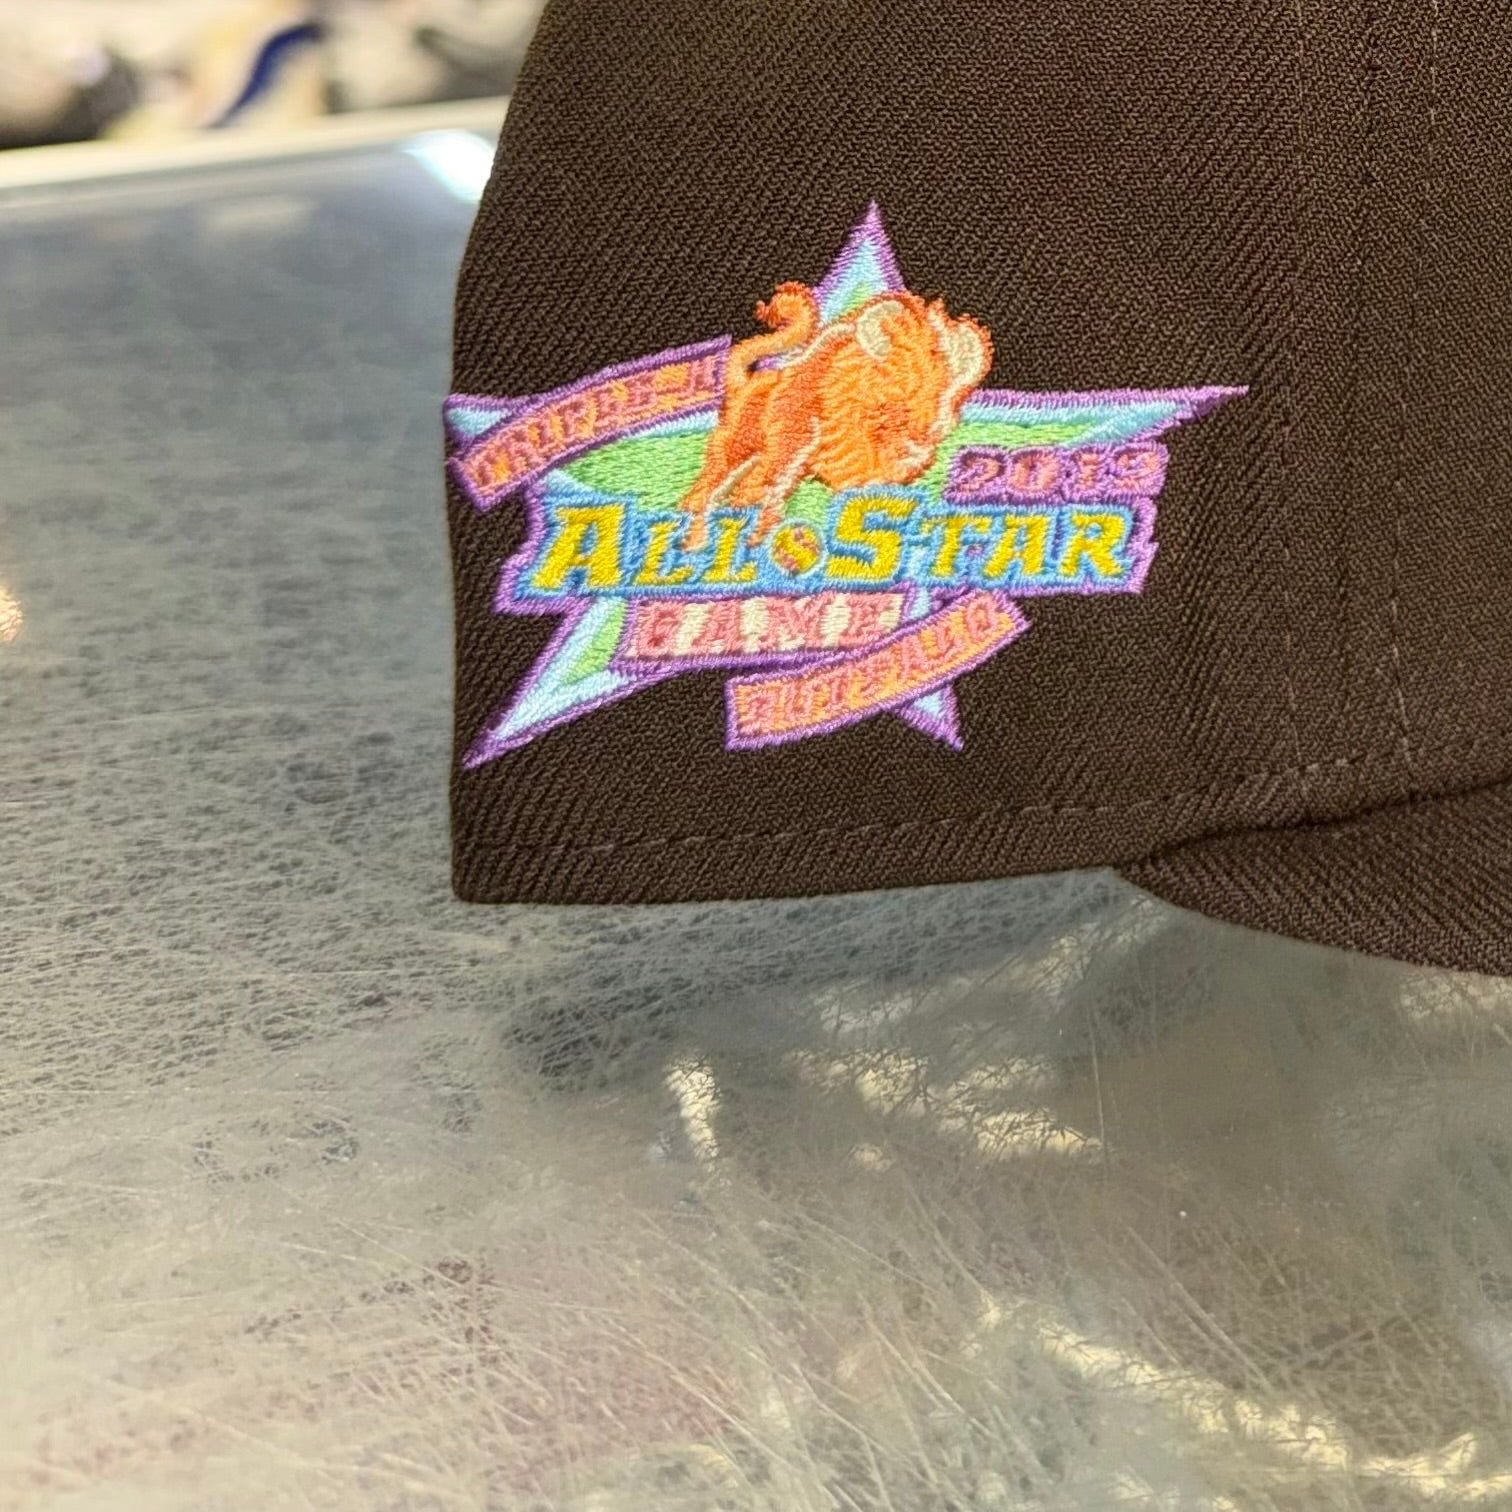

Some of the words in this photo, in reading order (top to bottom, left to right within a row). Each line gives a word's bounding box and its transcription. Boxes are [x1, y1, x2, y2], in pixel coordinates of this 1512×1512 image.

[531, 502, 758, 589] ALL
[824, 494, 1126, 582] STAR
[637, 592, 895, 657] GAME
